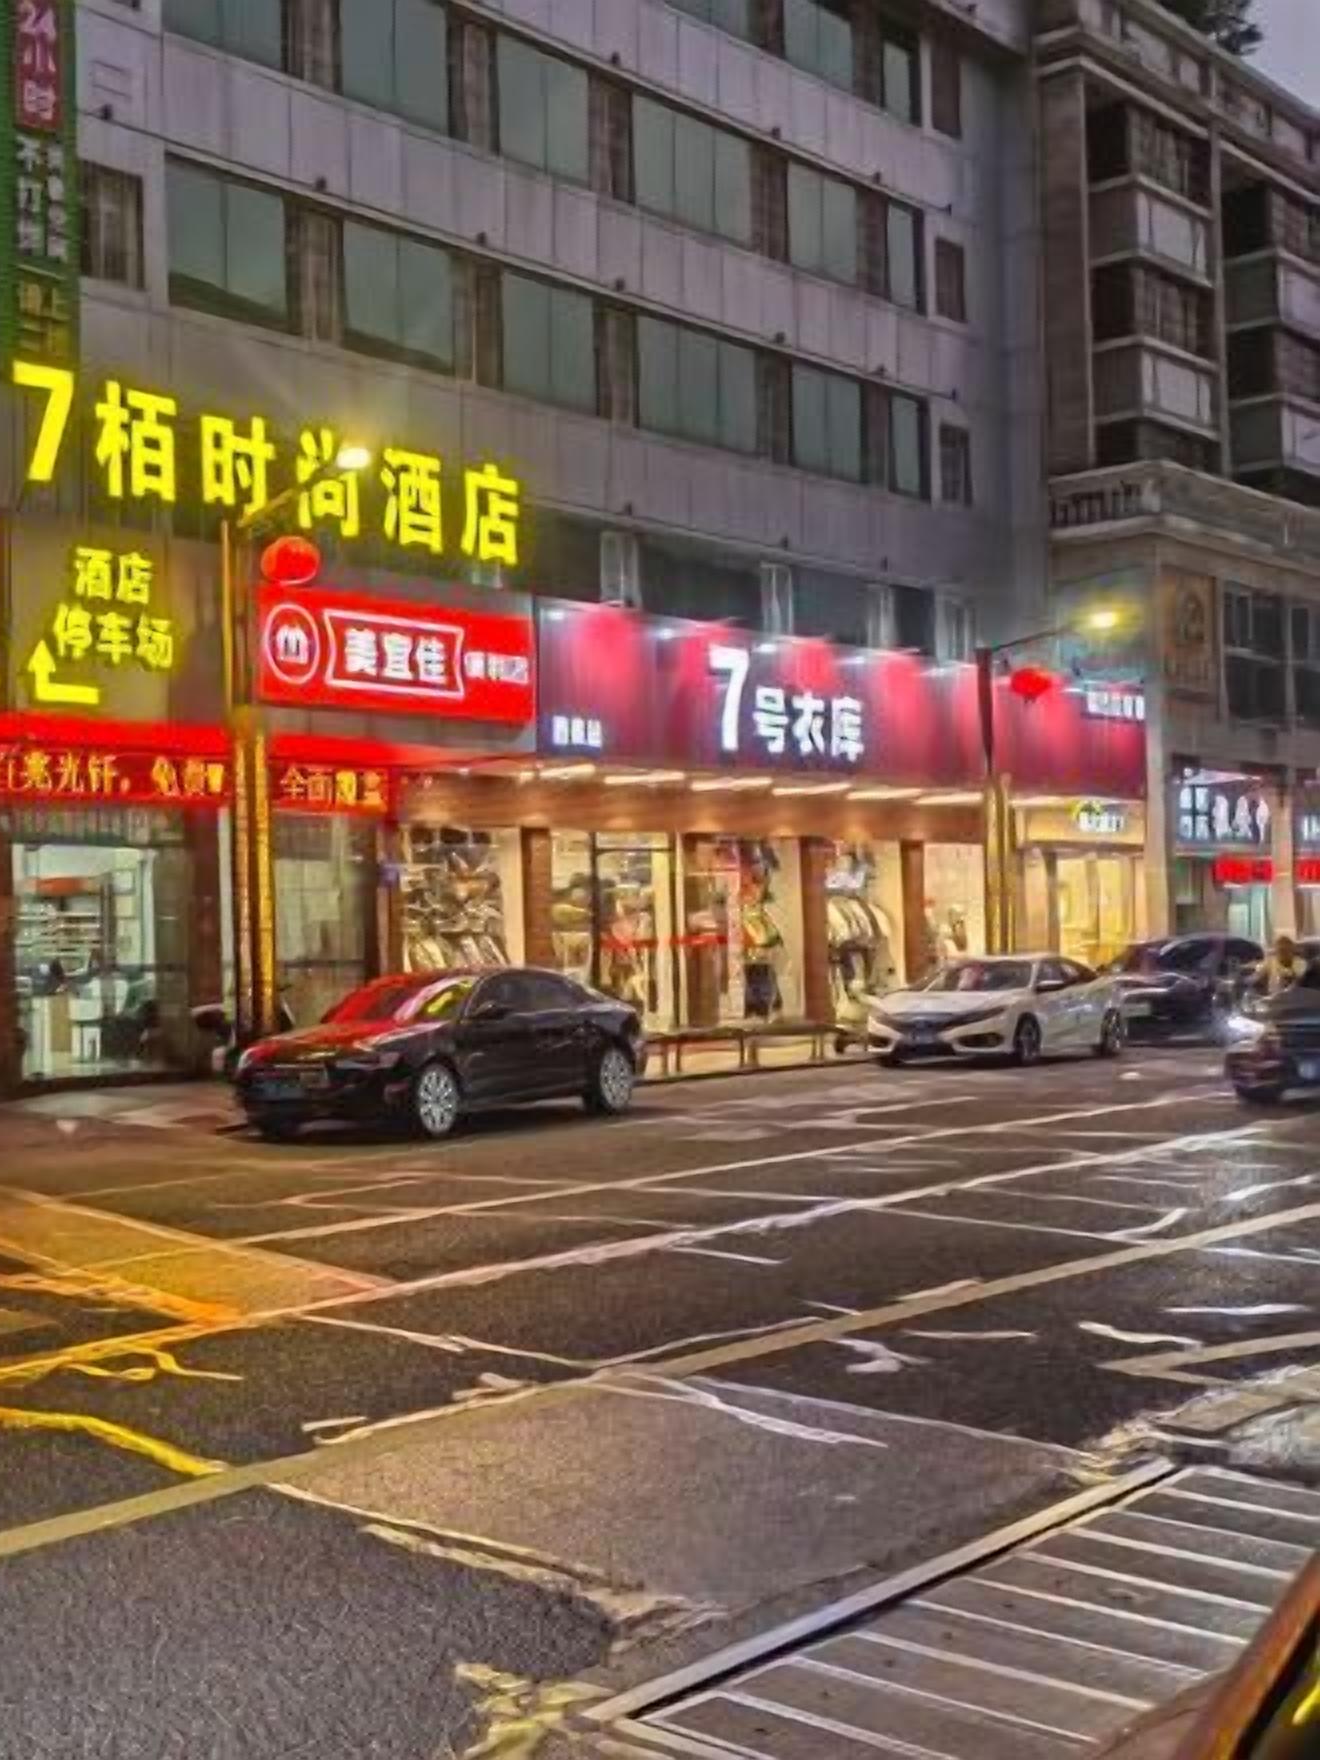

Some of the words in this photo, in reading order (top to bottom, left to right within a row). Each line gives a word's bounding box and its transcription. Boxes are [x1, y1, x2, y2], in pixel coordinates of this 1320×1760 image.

[75, 546, 154, 605] 酒店
[53, 602, 174, 670] 停车场
[344, 625, 447, 685] 美宜佳
[708, 642, 865, 763] 7号衣库
